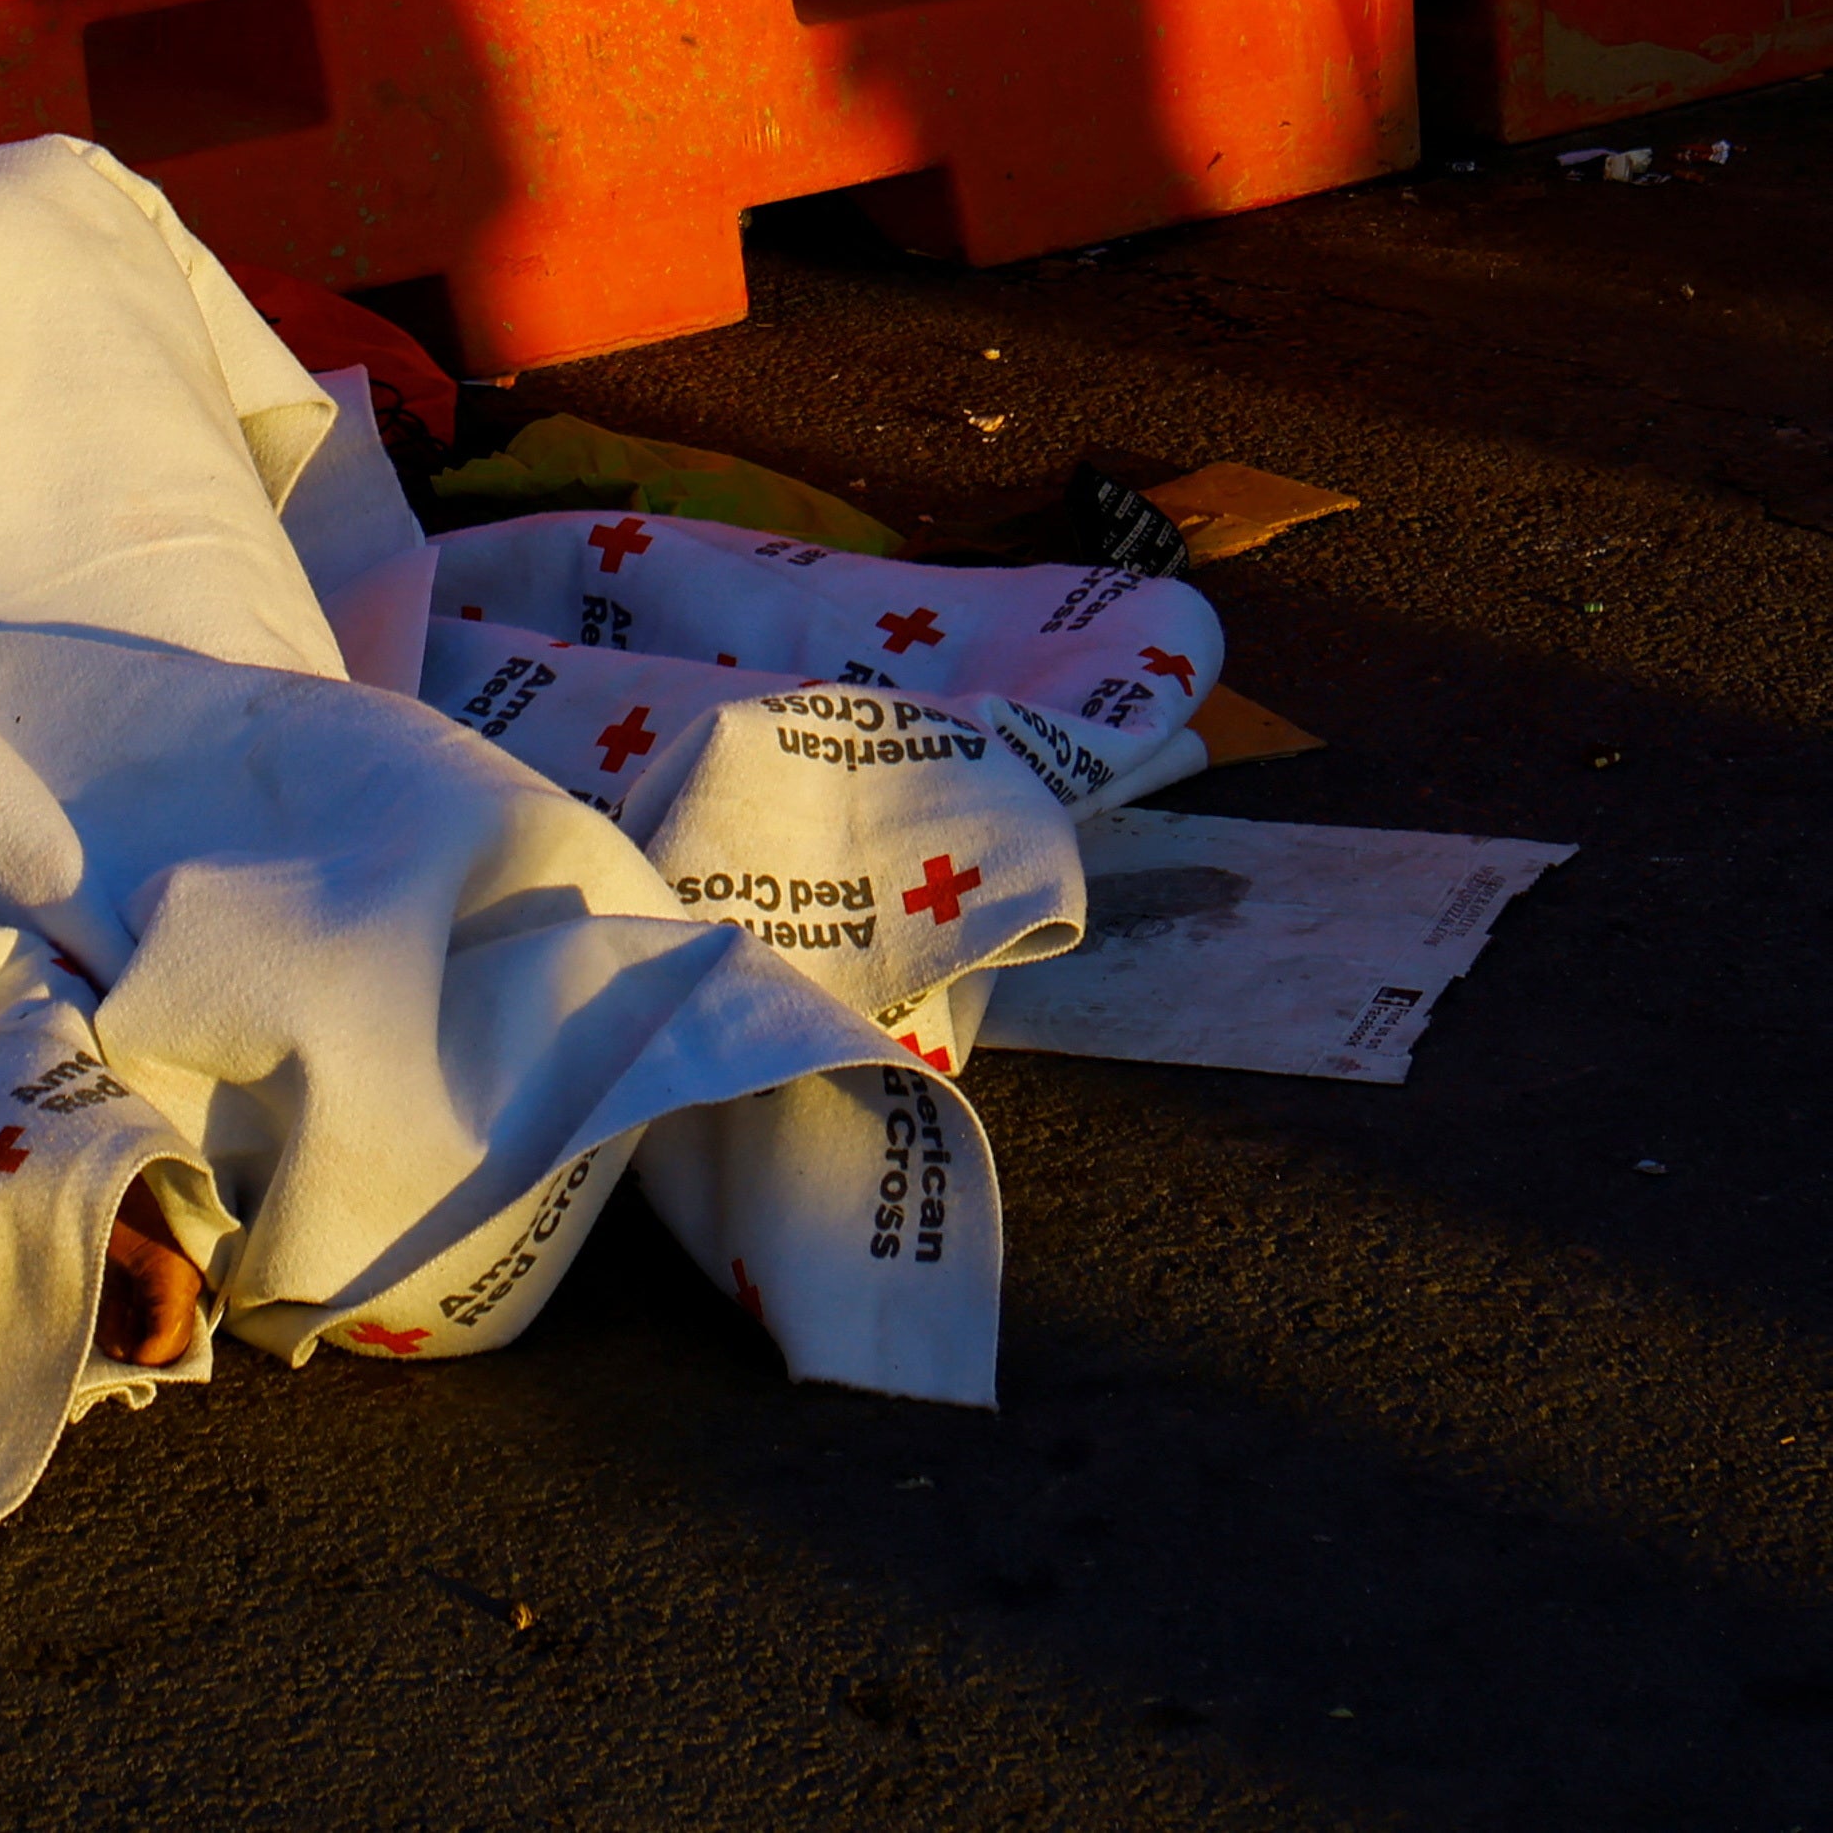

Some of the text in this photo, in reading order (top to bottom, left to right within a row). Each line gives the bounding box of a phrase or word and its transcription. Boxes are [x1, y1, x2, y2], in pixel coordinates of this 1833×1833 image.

[464, 657, 534, 718] Red
[761, 694, 883, 732] Cross
[776, 726, 986, 771] American
[791, 876, 874, 910] Red
[870, 1108, 918, 1261] Cross
[457, 1254, 537, 1328] Red
